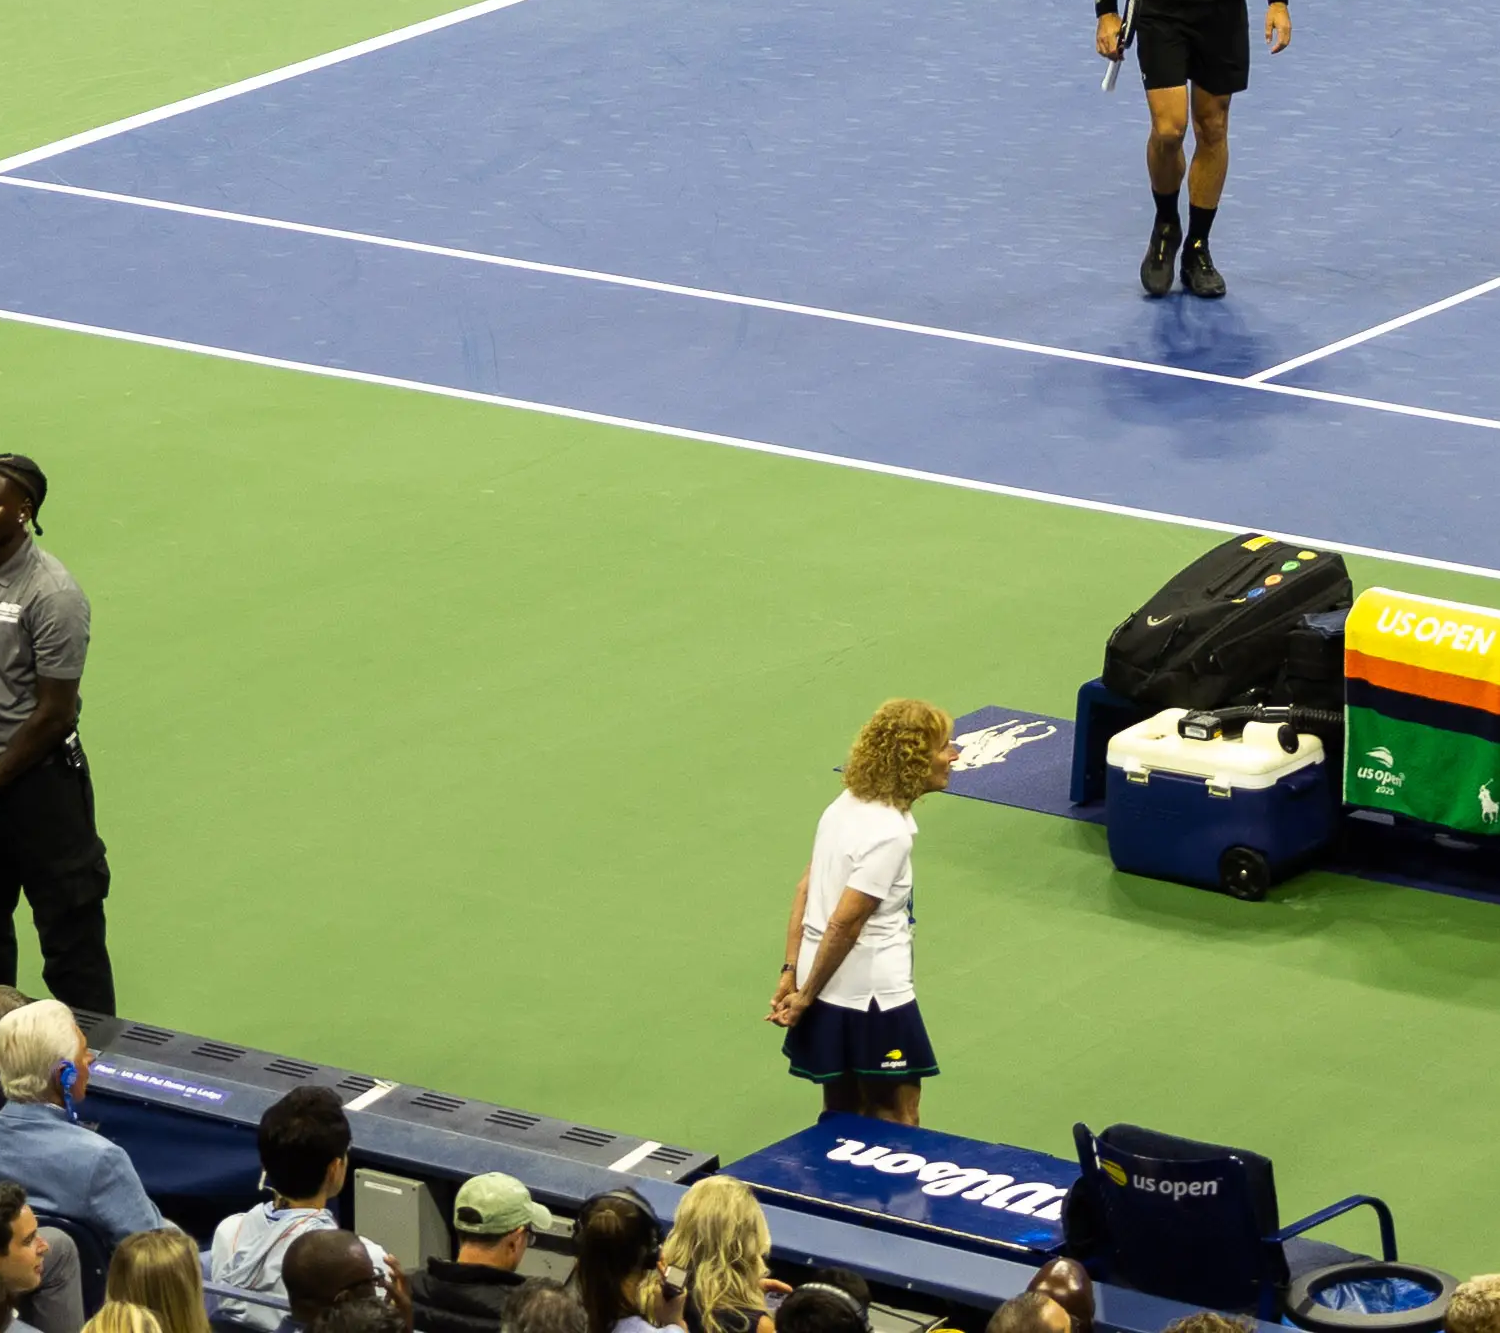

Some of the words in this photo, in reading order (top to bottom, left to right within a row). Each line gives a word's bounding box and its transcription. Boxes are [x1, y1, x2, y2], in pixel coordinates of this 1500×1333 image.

[1377, 606, 1414, 637] US
[1414, 617, 1498, 655] OPEN
[1356, 767, 1376, 780] us
[1375, 785, 1395, 796] 2025
[827, 1138, 1069, 1223] Wilson
[1133, 1174, 1154, 1191] us
[1158, 1180, 1218, 1202] open
